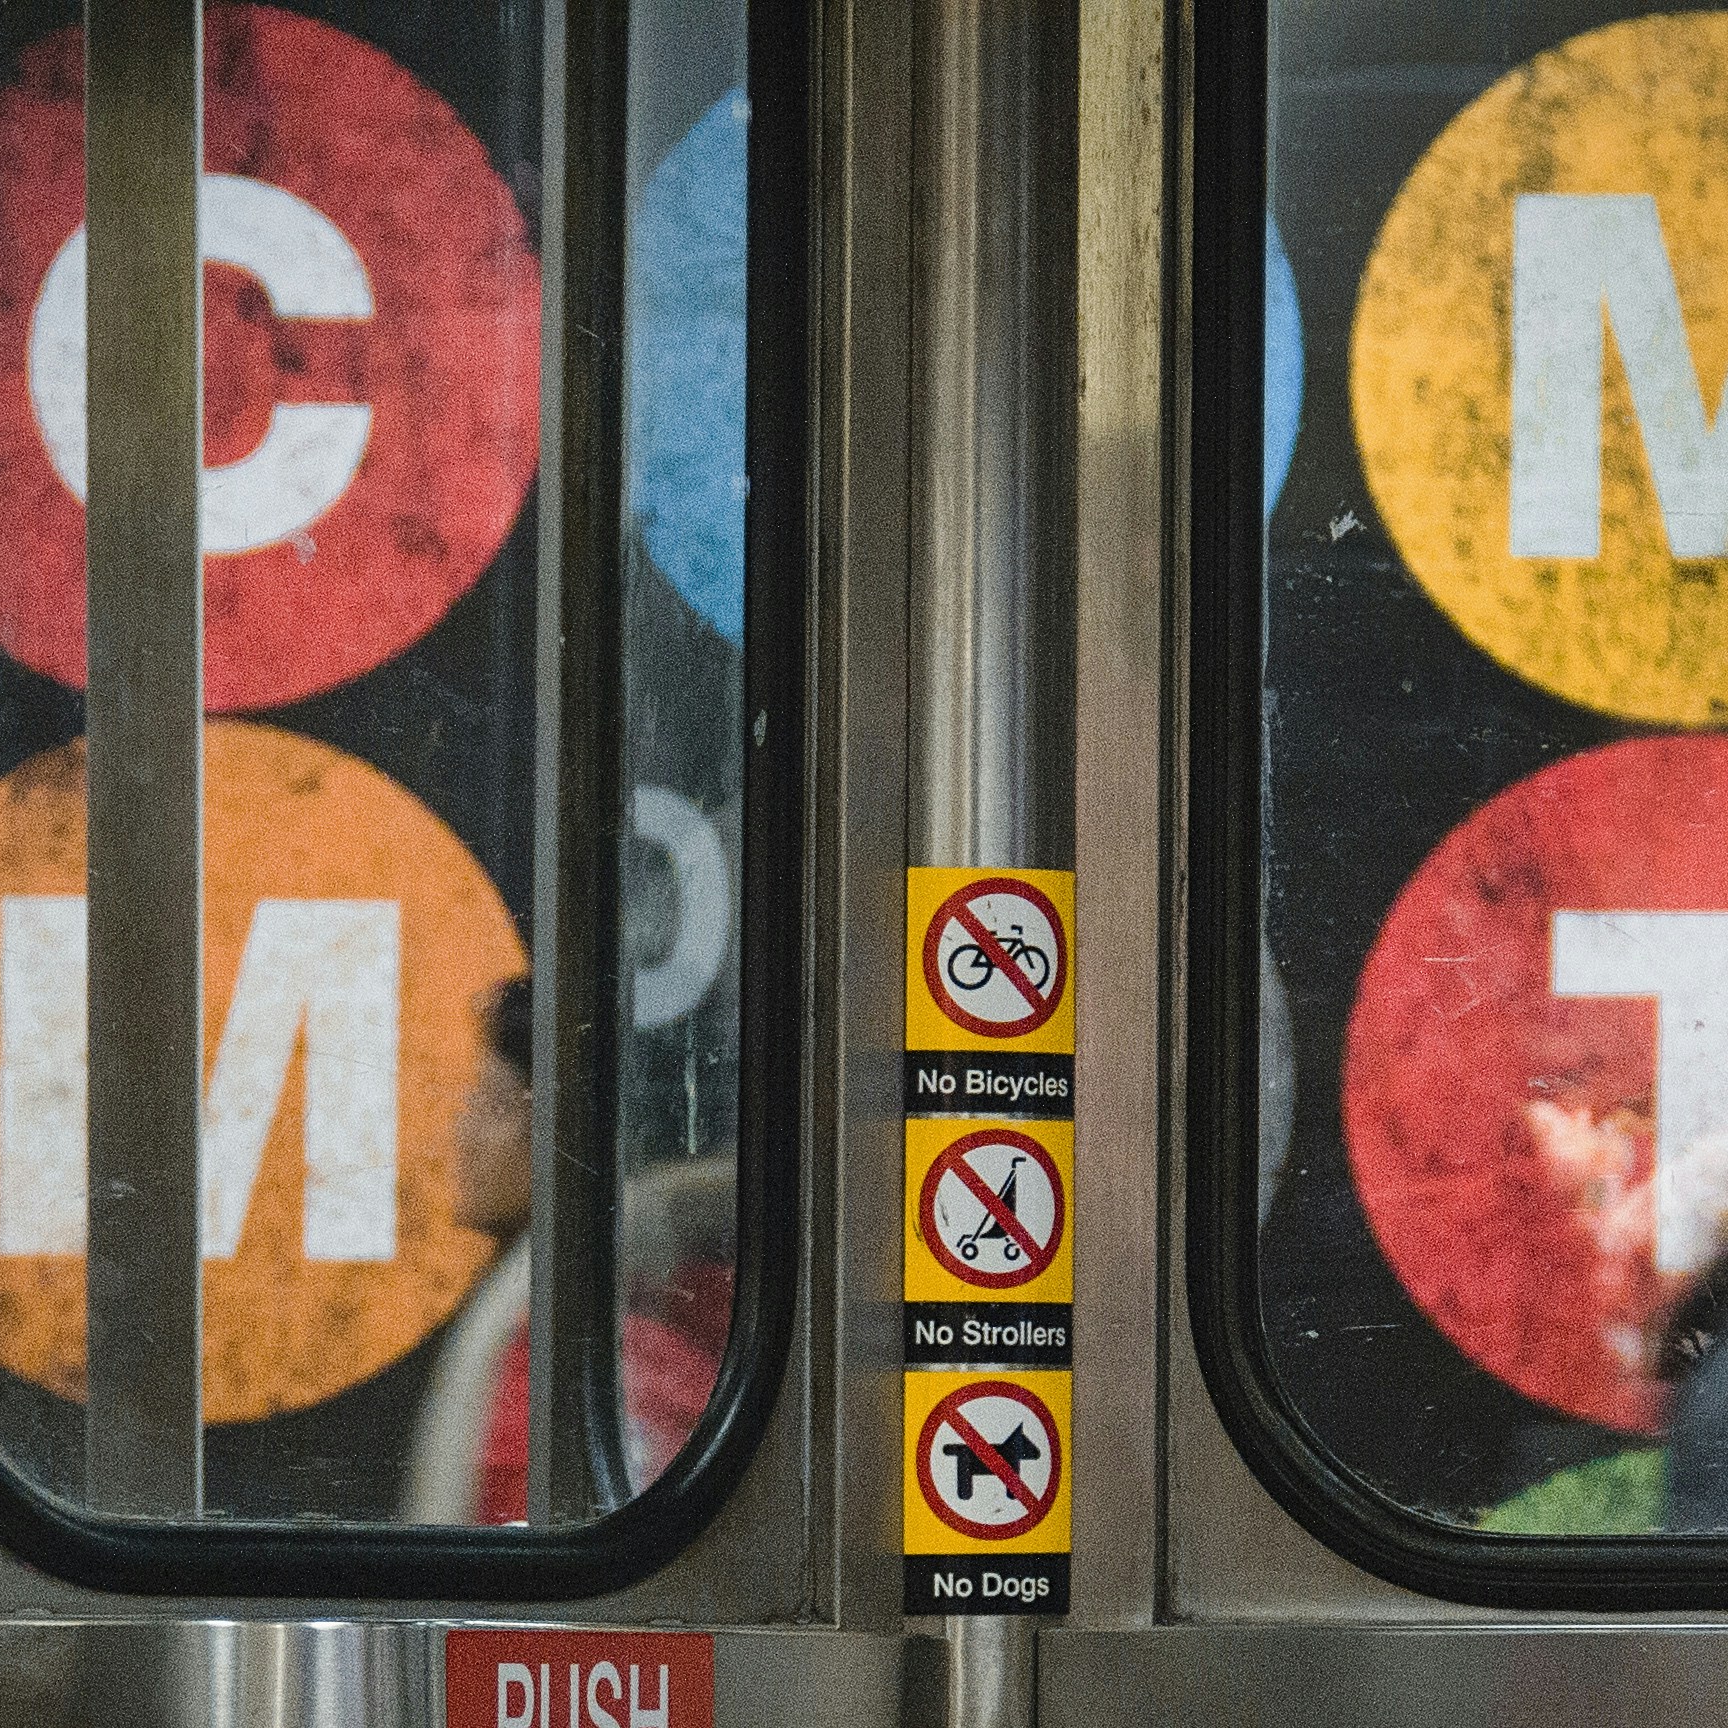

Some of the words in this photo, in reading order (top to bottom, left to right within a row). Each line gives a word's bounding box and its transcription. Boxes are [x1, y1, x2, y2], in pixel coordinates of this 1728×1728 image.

[27, 172, 374, 556] C
[917, 1069, 957, 1094] No
[965, 1069, 1069, 1101] Bicycles
[915, 1320, 954, 1345] No
[962, 1320, 1066, 1347] Strollers
[933, 1572, 973, 1597] No
[982, 1572, 1050, 1602] Dogs
